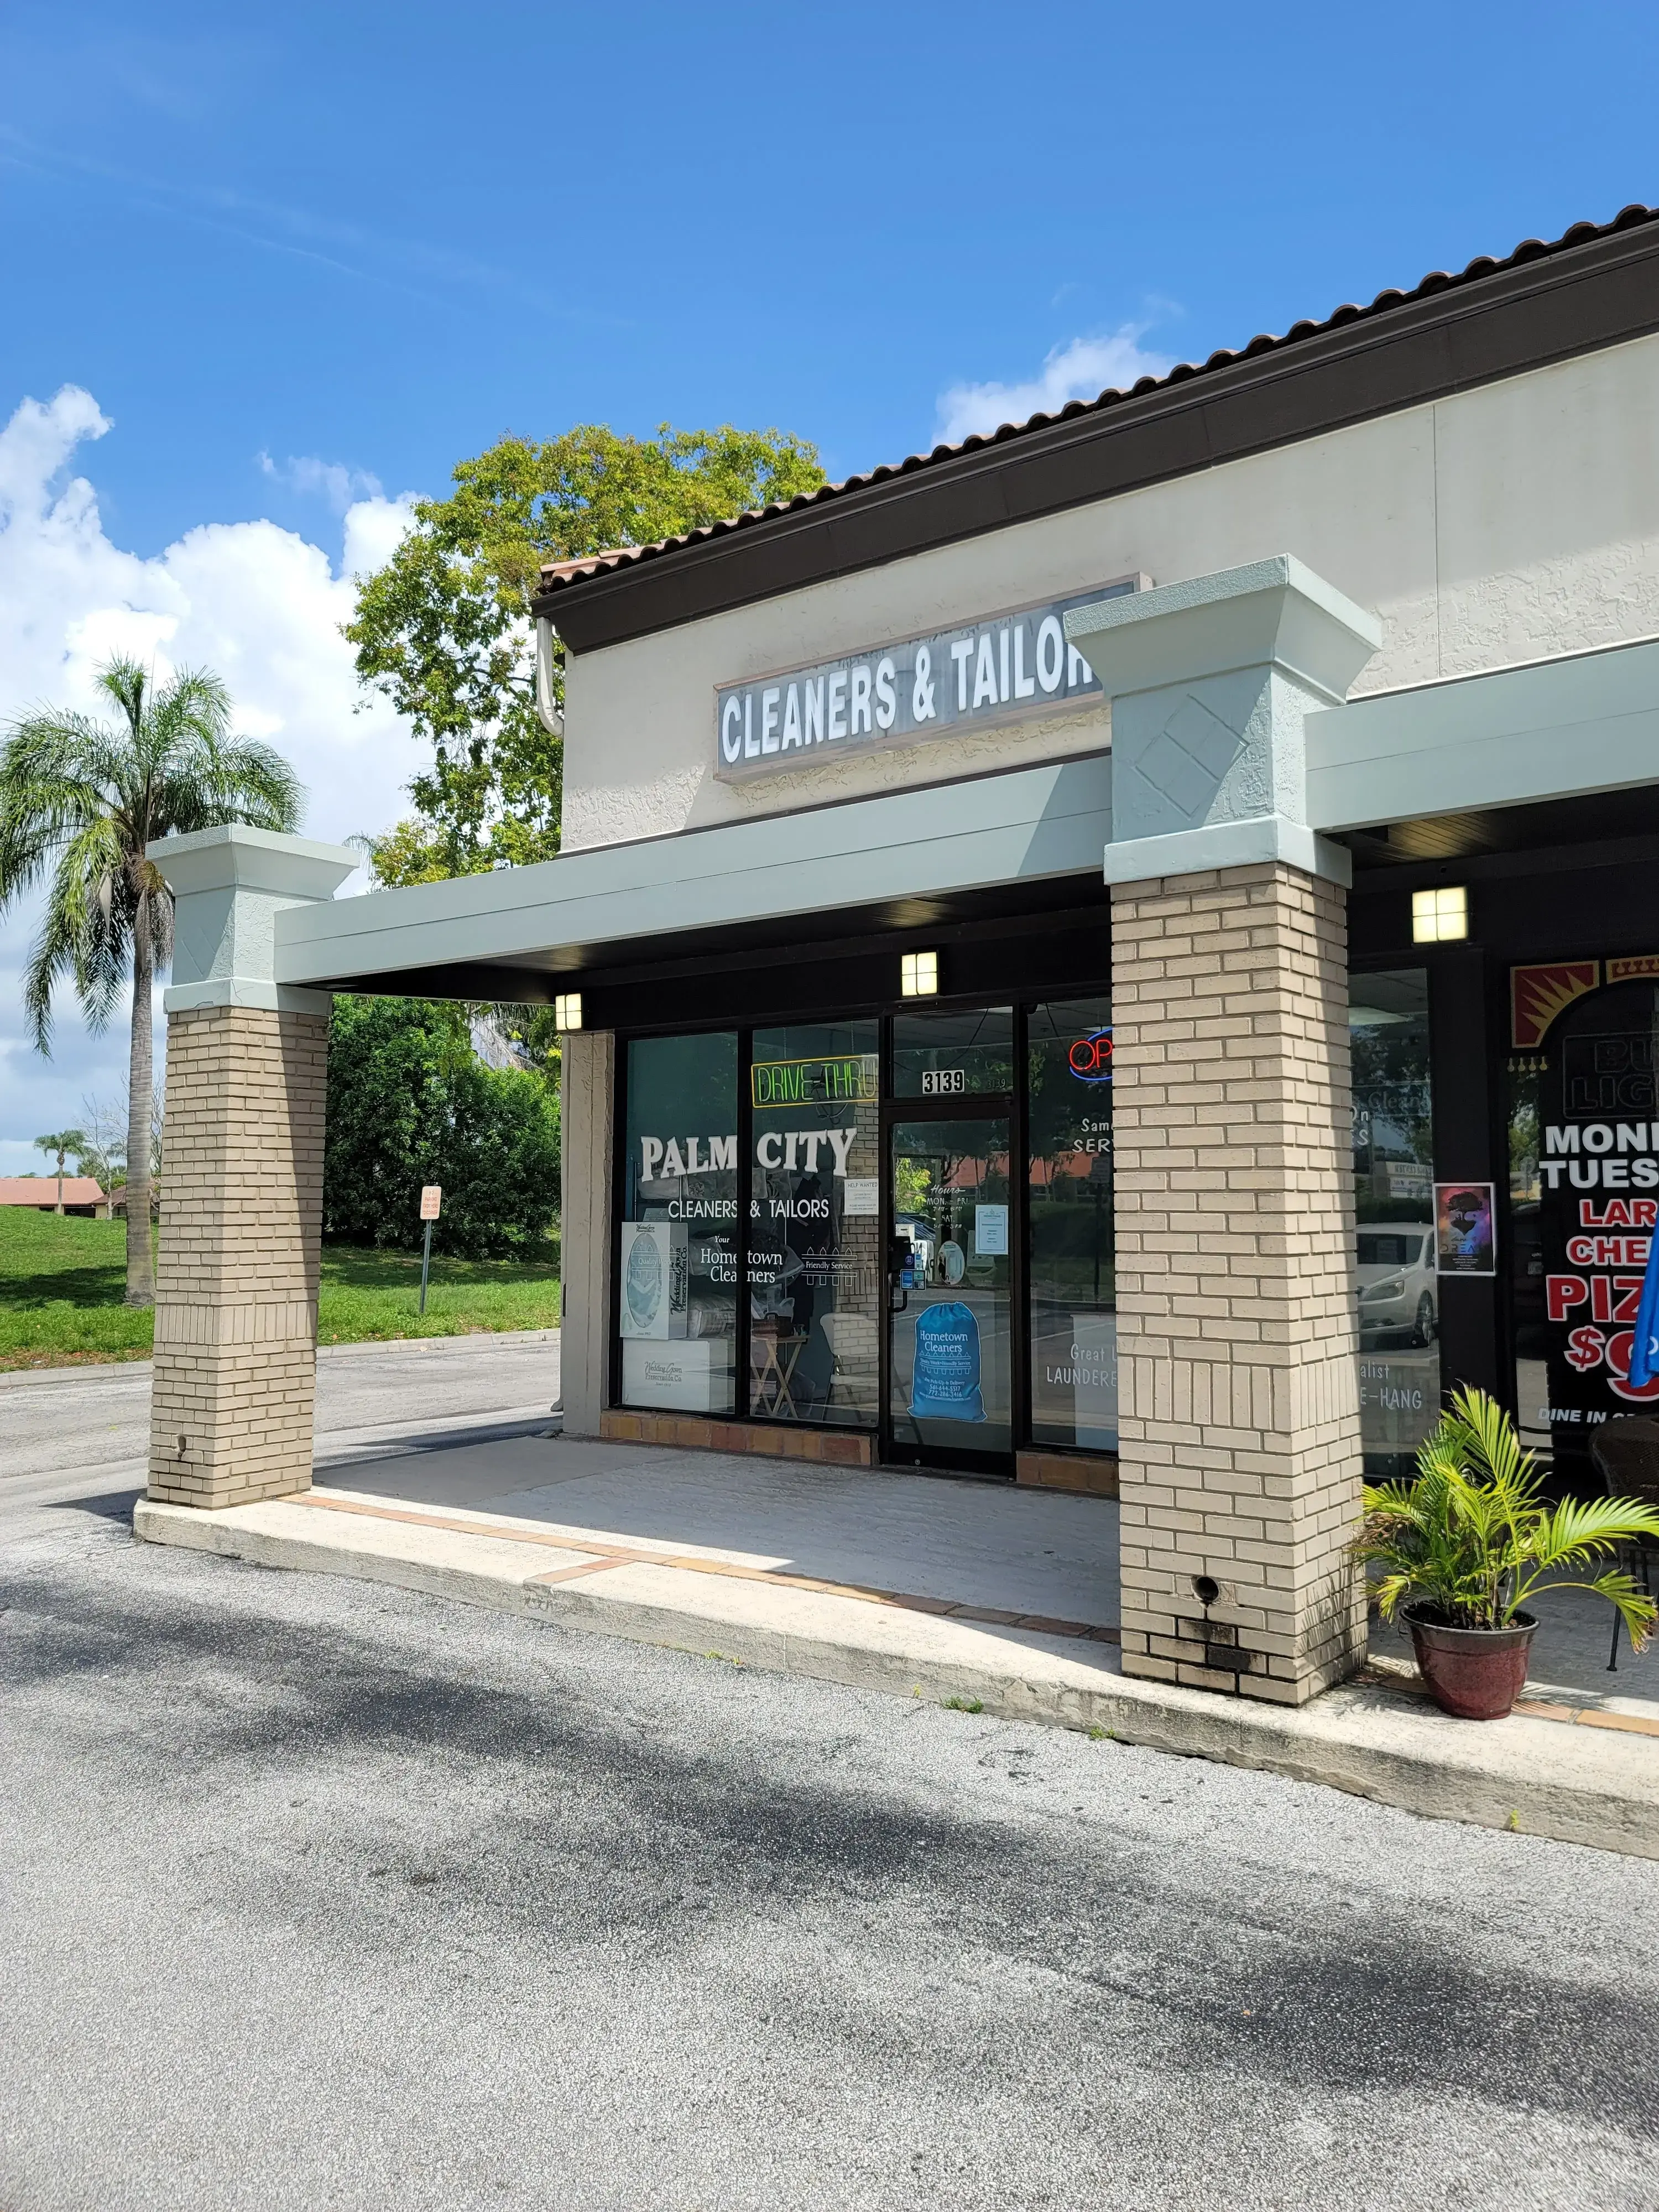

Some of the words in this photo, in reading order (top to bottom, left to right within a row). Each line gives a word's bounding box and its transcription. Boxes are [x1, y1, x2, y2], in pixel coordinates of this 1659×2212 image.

[722, 657, 896, 763] CLEANERS
[912, 644, 936, 723] &
[758, 1061, 878, 1102] DRIVE-THRU
[924, 1071, 963, 1092] 3139
[1072, 1138, 1114, 1153] SER
[640, 1135, 737, 1183] PALM
[757, 1127, 857, 1178] CITY
[931, 1185, 966, 1194] Hours
[669, 1200, 737, 1218] CLEANERS
[750, 1199, 761, 1218] &
[769, 1199, 829, 1218] TAILORS
[926, 1197, 947, 1206] MON.
[714, 1235, 730, 1243] Your
[638, 1258, 658, 1267] Quality
[806, 1261, 830, 1270] Friendly
[920, 1330, 968, 1341] Hometown
[925, 1341, 962, 1352] Cleaners
[1071, 1344, 1104, 1361] Great
[1537, 1407, 1582, 1422] DINE
[1587, 1411, 1606, 1423] IN
